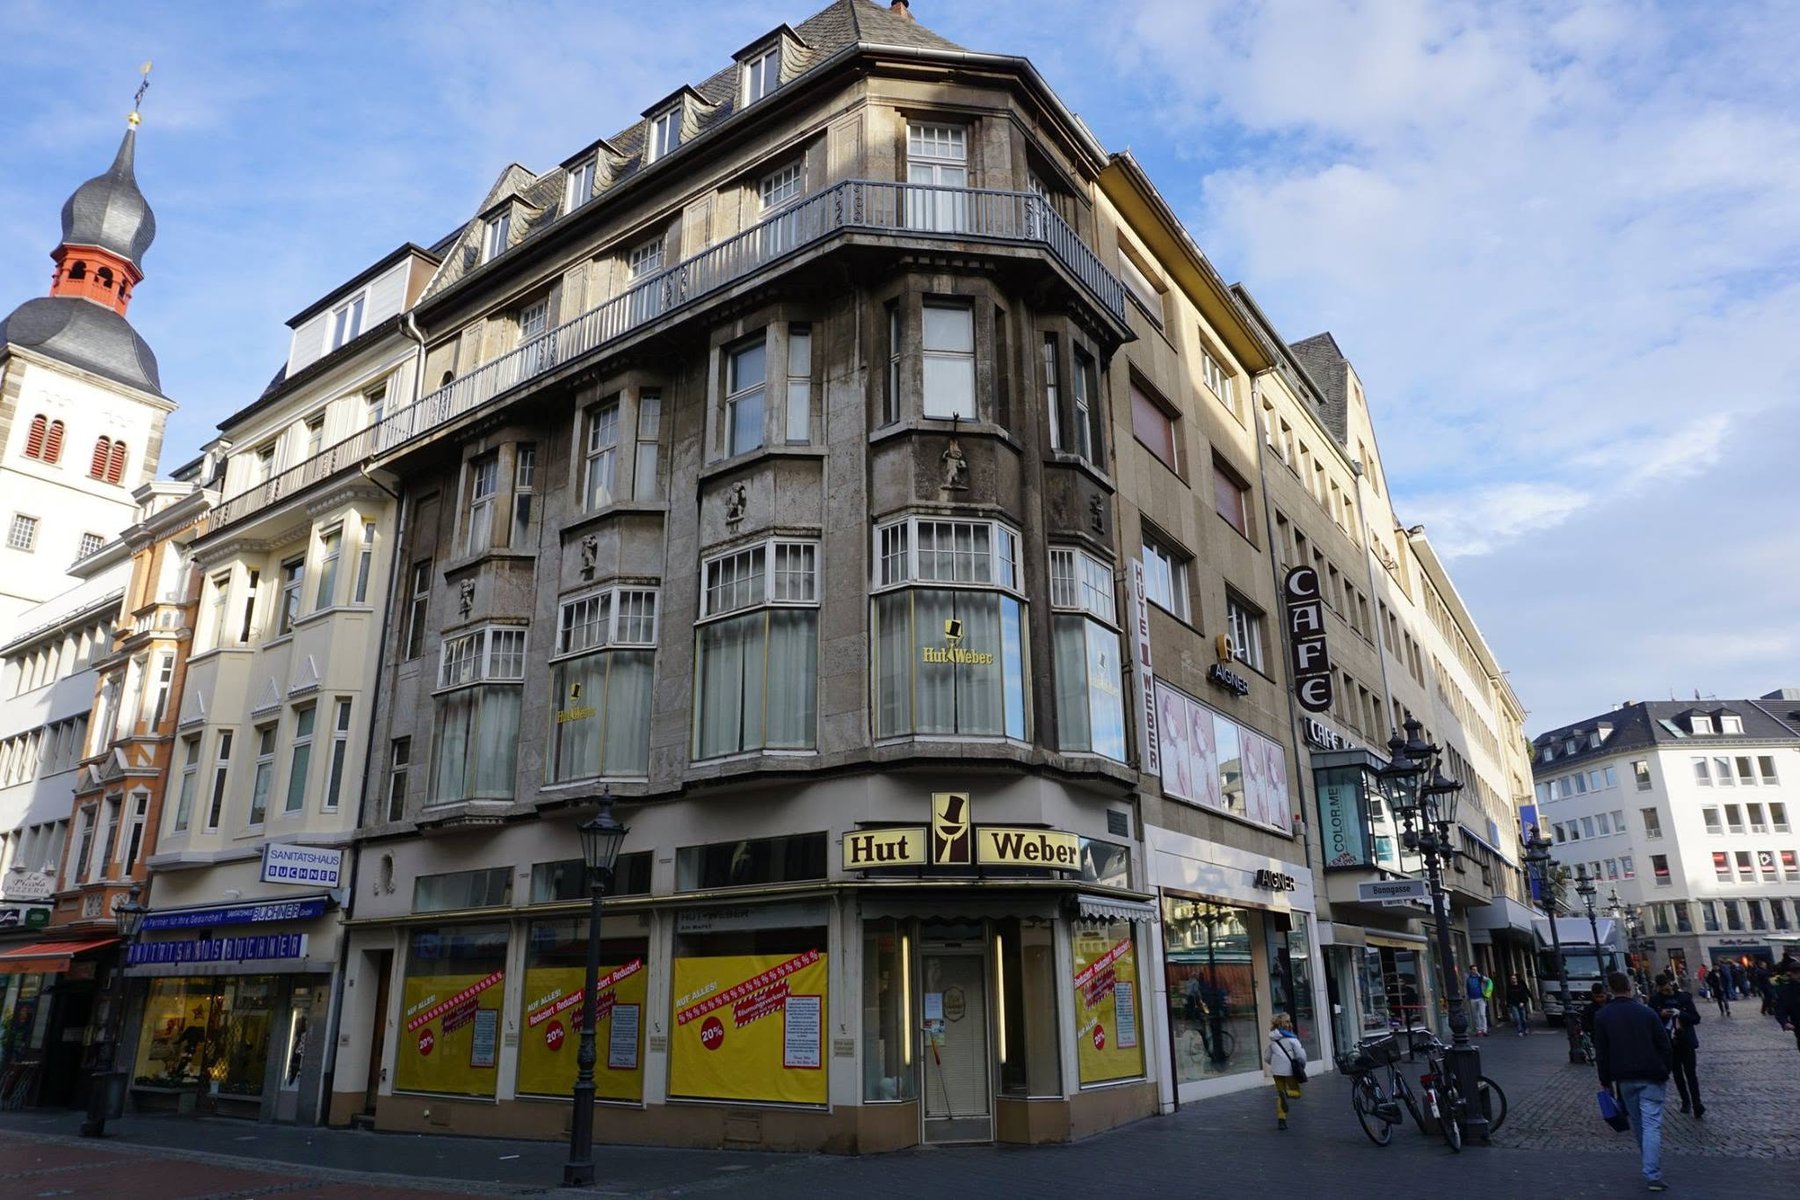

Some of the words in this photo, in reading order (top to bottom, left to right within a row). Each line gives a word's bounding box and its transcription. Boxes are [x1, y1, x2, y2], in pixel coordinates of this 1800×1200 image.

[1289, 570, 1327, 705] CAFE
[923, 647, 948, 662] Hut
[954, 648, 993, 664] Weber
[1215, 664, 1249, 693] AIGNER
[1143, 672, 1157, 770] WEBER
[1328, 787, 1344, 852] COLOR.ME
[851, 836, 909, 863] Hut
[991, 832, 1077, 864] Weber
[6, 886, 50, 894] PIZZERIA
[1262, 870, 1295, 891] AIGNER
[1373, 886, 1411, 896] Bonngasse
[613, 960, 640, 981] Reduziert
[676, 995, 691, 1007] AUF
[692, 982, 718, 1000] ALLES!
[528, 1000, 539, 1012] AUF
[419, 1035, 434, 1050] 20%
[546, 1028, 564, 1044] 20%
[702, 1026, 723, 1042] 20%
